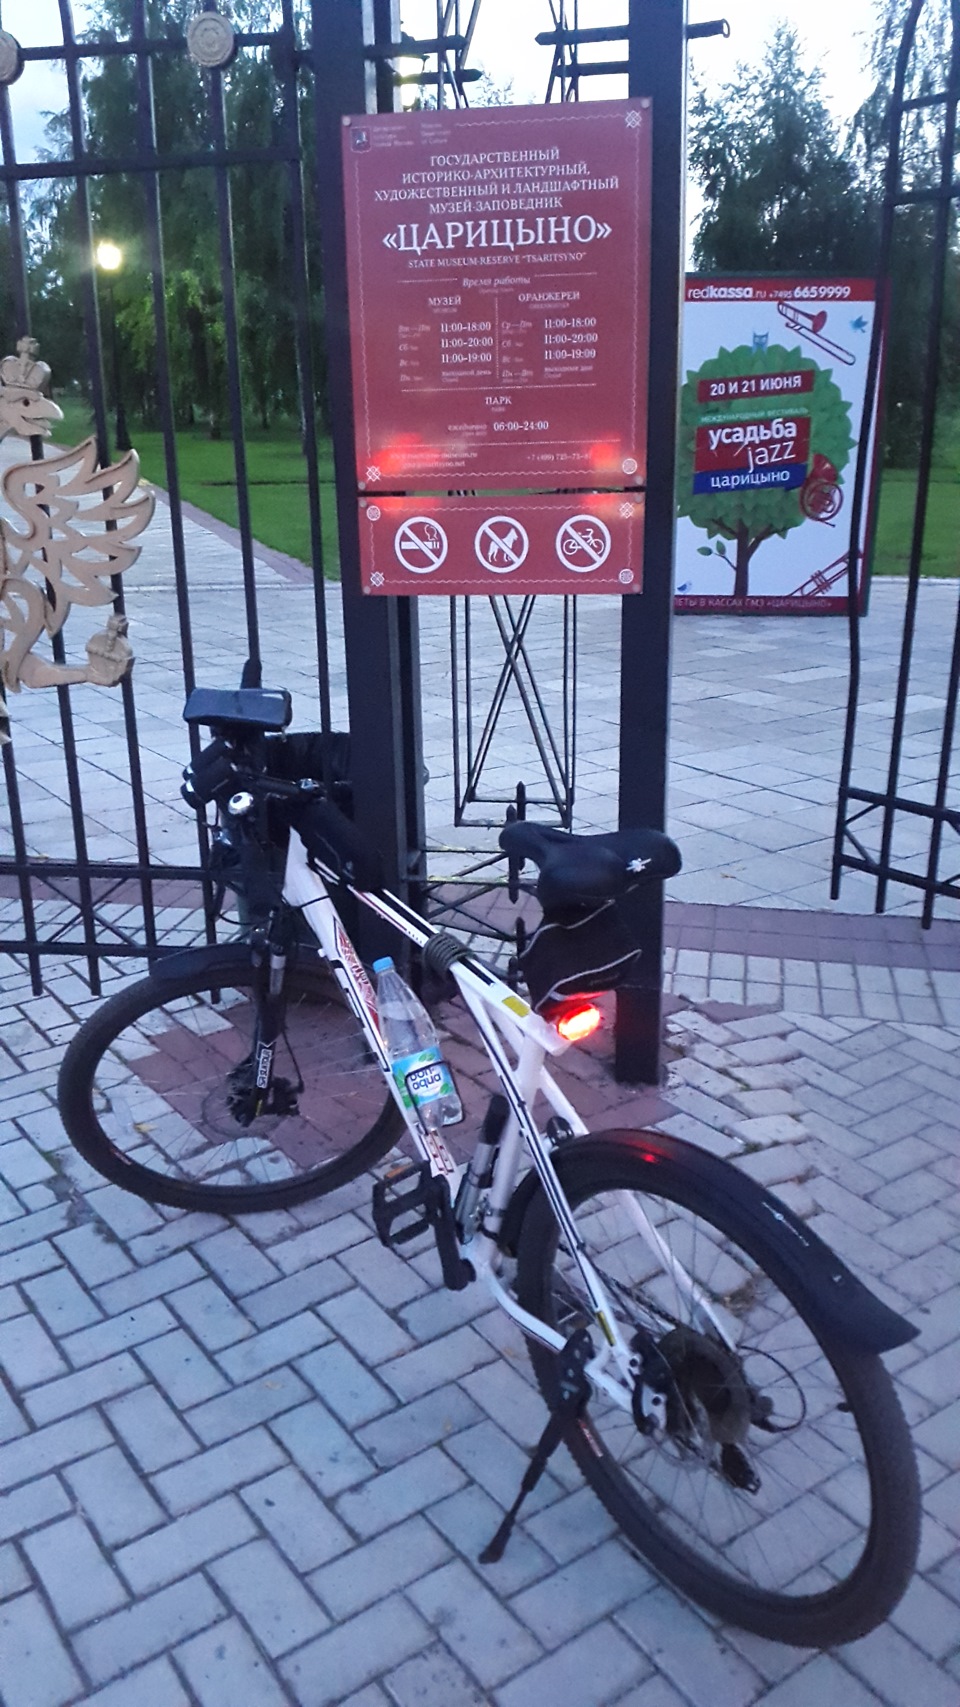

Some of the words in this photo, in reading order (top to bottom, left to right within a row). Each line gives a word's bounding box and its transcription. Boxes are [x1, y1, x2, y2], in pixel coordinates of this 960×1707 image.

[430, 146, 560, 167] ГОСУДАРСТВЕННЫЙ
[402, 161, 591, 184] ИСТОРИКО-АРХИТЕКТУРНЫЙ,
[374, 181, 498, 201] ХУДОЖЕСТВЕННЫЙ
[501, 183, 511, 195] И
[513, 175, 619, 193] ЛАНДШАФТНЫЙ
[429, 197, 563, 214] МУЗЕЙ-ЗАПОВЕДНИК
[382, 215, 612, 255] «ЦАРИЦЫНО»
[408, 259, 435, 269] STATE
[437, 255, 520, 267] MUSEUM-RESERVE
[462, 277, 492, 288] Время
[494, 276, 531, 287] работы
[428, 295, 461, 306] МУЗЕЙ
[518, 291, 580, 302] ОРАНЖЕРЕИ
[687, 285, 766, 299] redkassa.ru
[768, 291, 793, 299] +7495
[794, 286, 851, 299] 6659999
[710, 383, 725, 397] 20
[729, 382, 738, 394] И
[742, 380, 756, 393] 21
[760, 375, 802, 391] ИЮНЯ
[485, 396, 512, 405] ПАРК
[709, 418, 797, 450] усадьба
[748, 441, 796, 473] jazz
[711, 470, 790, 488] царицыно
[708, 598, 743, 607] КАССАХ
[412, 1074, 442, 1091] aqua
